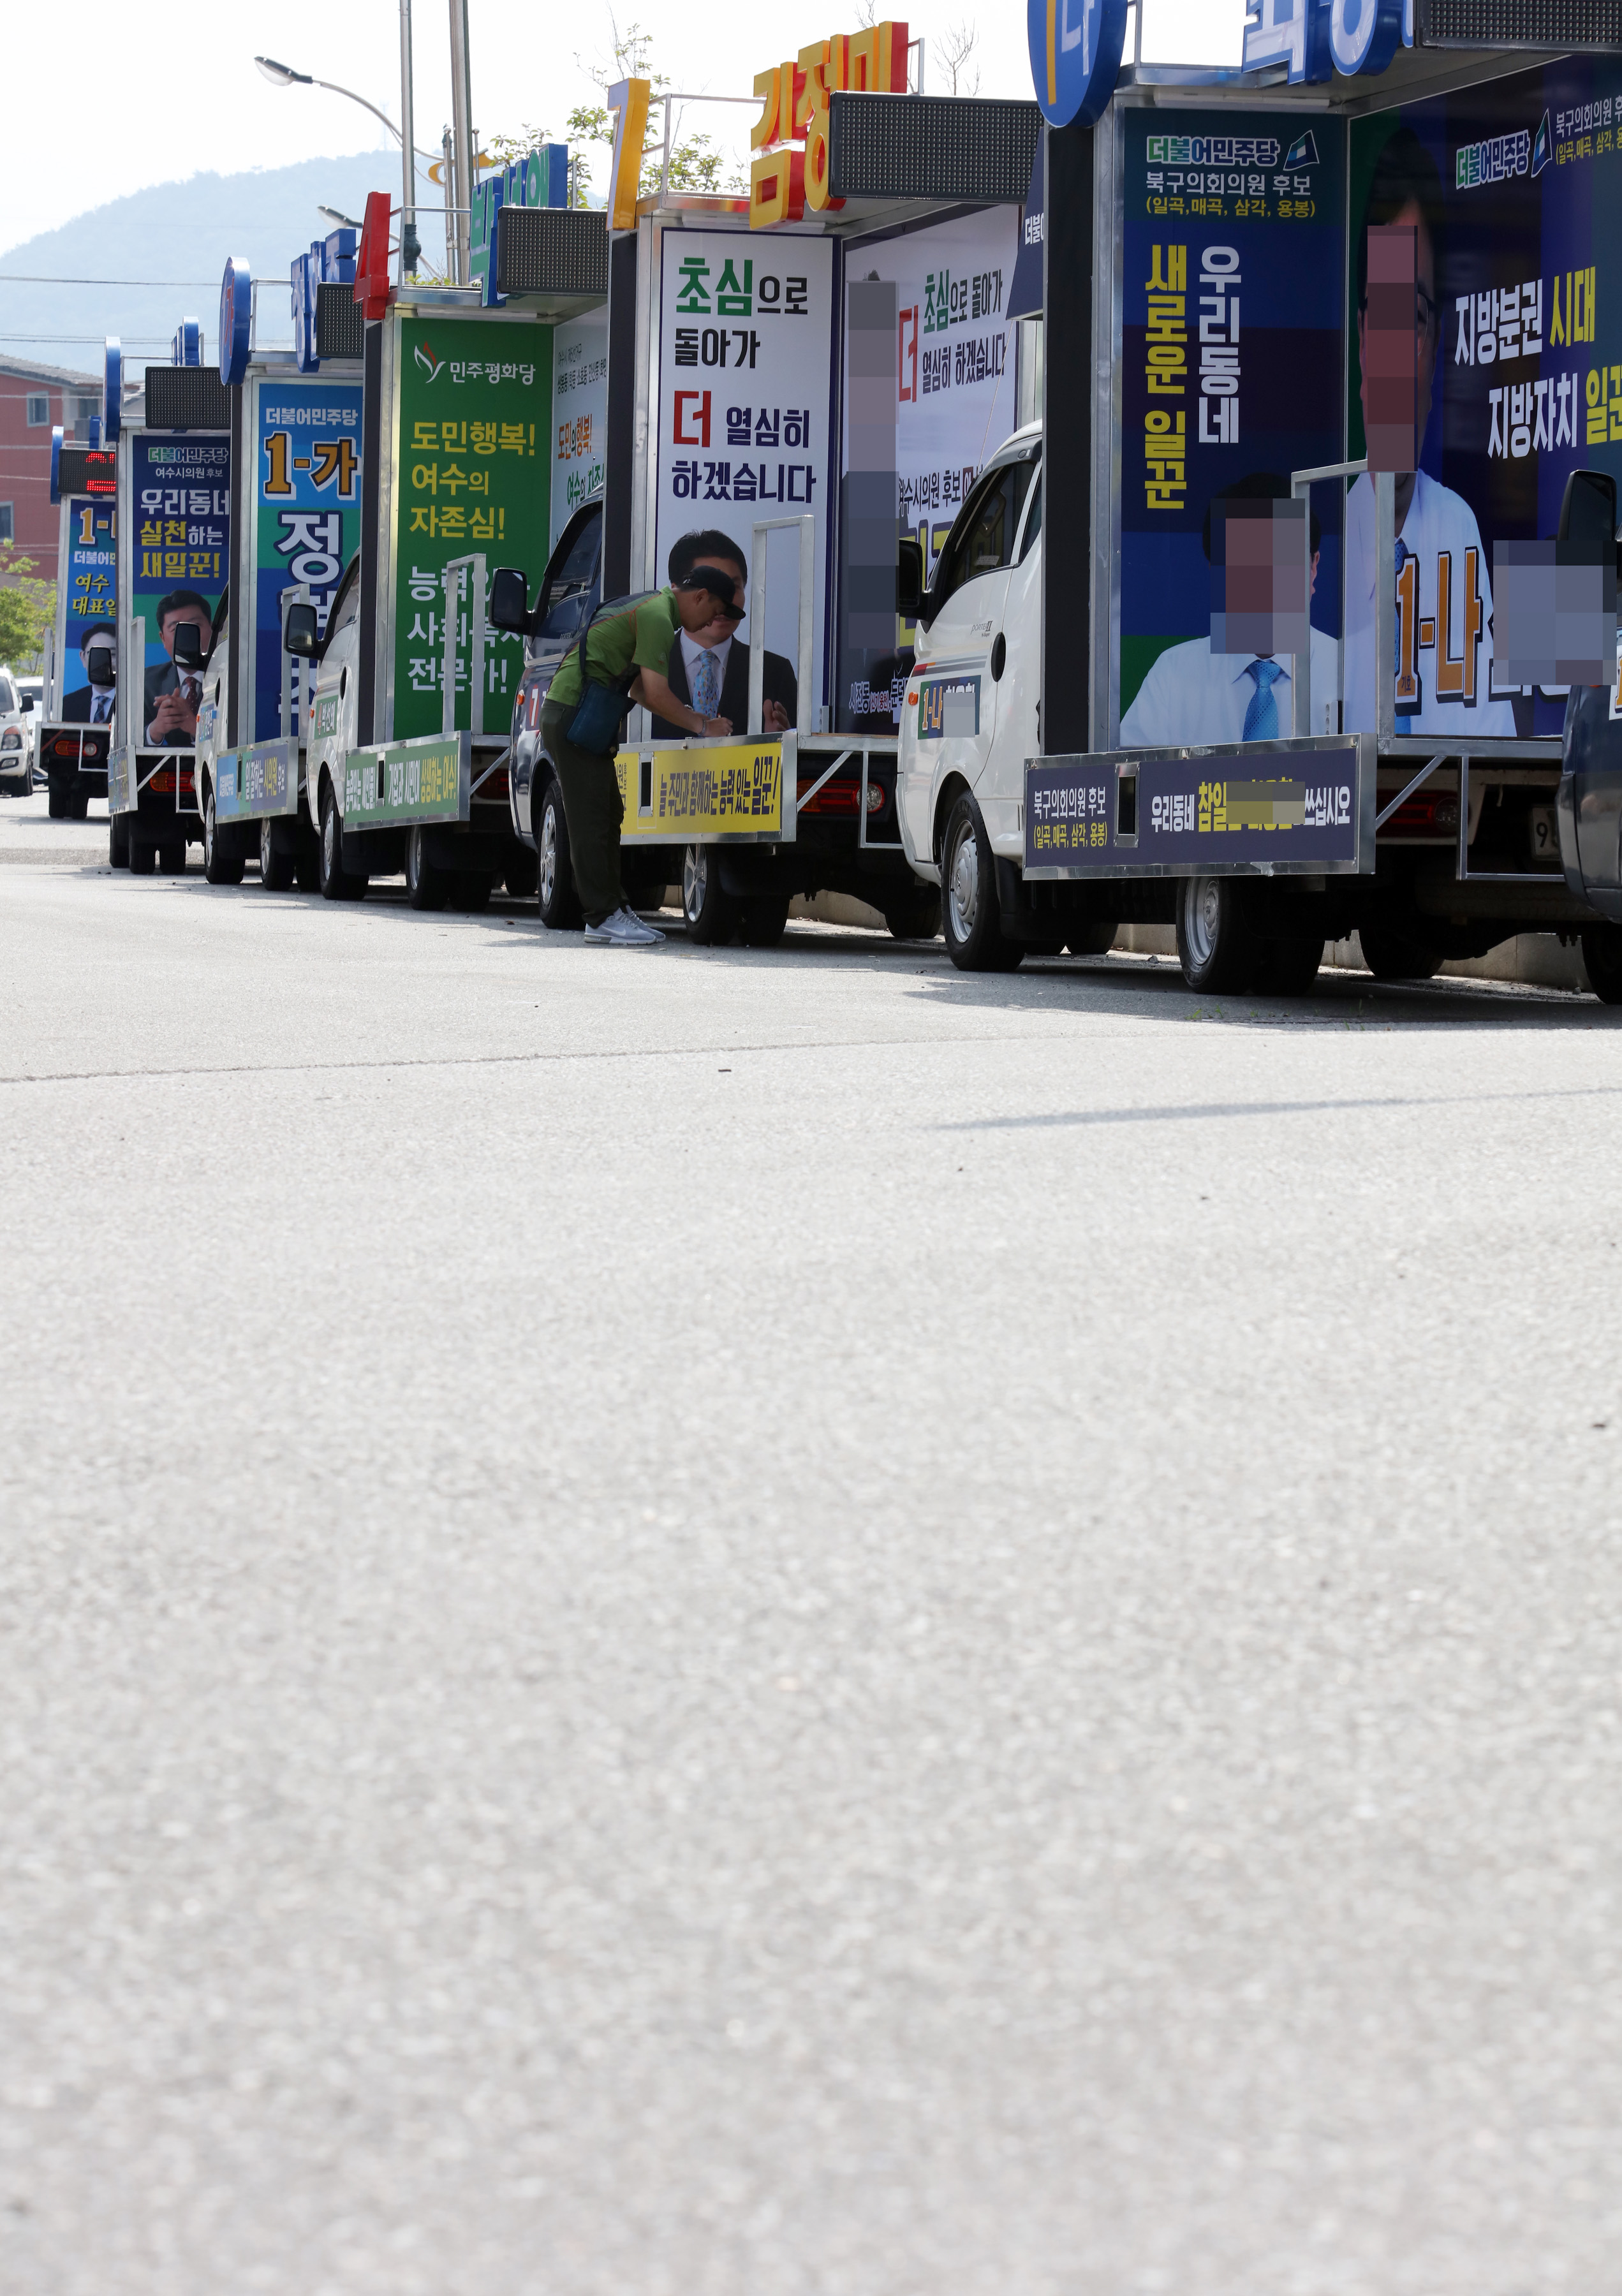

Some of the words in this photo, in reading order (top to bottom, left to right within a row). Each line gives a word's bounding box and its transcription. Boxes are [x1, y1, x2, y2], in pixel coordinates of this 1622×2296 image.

[607, 78, 650, 230] 7
[1146, 135, 1280, 166] 더불어민주당
[1456, 129, 1530, 190] 더불어민주당
[1556, 97, 1612, 138] 북구의회의원
[1146, 172, 1265, 195] 북구의회의원
[1272, 175, 1311, 196] 후보
[1235, 198, 1271, 217] 삼각,
[1277, 200, 1315, 218] 용봉)
[353, 191, 390, 320] 4
[676, 257, 808, 316] 초심으로
[924, 269, 968, 334] 초심으로
[972, 269, 1003, 320] 돌아가
[1145, 244, 1188, 394] 새로운
[1454, 278, 1543, 367] 지방분권
[1549, 266, 1596, 348] 시대
[675, 328, 760, 369] 돌아가
[899, 304, 918, 402] 더
[922, 346, 951, 394] 열심히
[955, 332, 1006, 385] 하겠습니다
[1198, 246, 1241, 443] 우리동네
[450, 362, 536, 385] 민주평화당
[266, 408, 358, 426] 더불어민주당
[673, 390, 712, 448] 더
[726, 407, 809, 448] 열심히
[1487, 372, 1578, 459] 지방자치
[148, 447, 228, 463] 더불어민주당
[411, 421, 535, 456] 도민행복!
[1144, 410, 1187, 509] 일꾼
[156, 467, 205, 478] 여수시의원
[207, 468, 223, 478] 후보
[263, 430, 362, 501] 1-가
[411, 463, 489, 496] 여수의
[672, 460, 816, 503] 하겠습니다
[942, 469, 961, 507] 후보
[79, 508, 115, 544] 1-
[140, 520, 223, 546] 실천하는
[409, 505, 505, 540] 자존심!
[75, 573, 109, 593] 여수
[140, 552, 221, 578] 새일꾼!
[1395, 546, 1483, 717] 1-나
[922, 686, 943, 731] 1-나
[388, 762, 403, 807] 기업과
[404, 760, 420, 805] 시민이
[421, 756, 441, 803] 상생하는
[443, 754, 457, 800] 여수!
[659, 774, 667, 817] 늘
[668, 772, 689, 816] 주민과
[689, 769, 718, 816] 함께하는
[719, 769, 735, 814] 능력
[735, 769, 751, 814] 있는
[751, 756, 780, 815] 일꾼!
[1034, 787, 1086, 820] 북구의회의원
[1088, 786, 1106, 816] 후보
[1151, 794, 1195, 833] 우리동네
[1198, 781, 1242, 832] 참일
[1071, 823, 1087, 847] 삼각,
[1090, 821, 1108, 847] 용봉)
